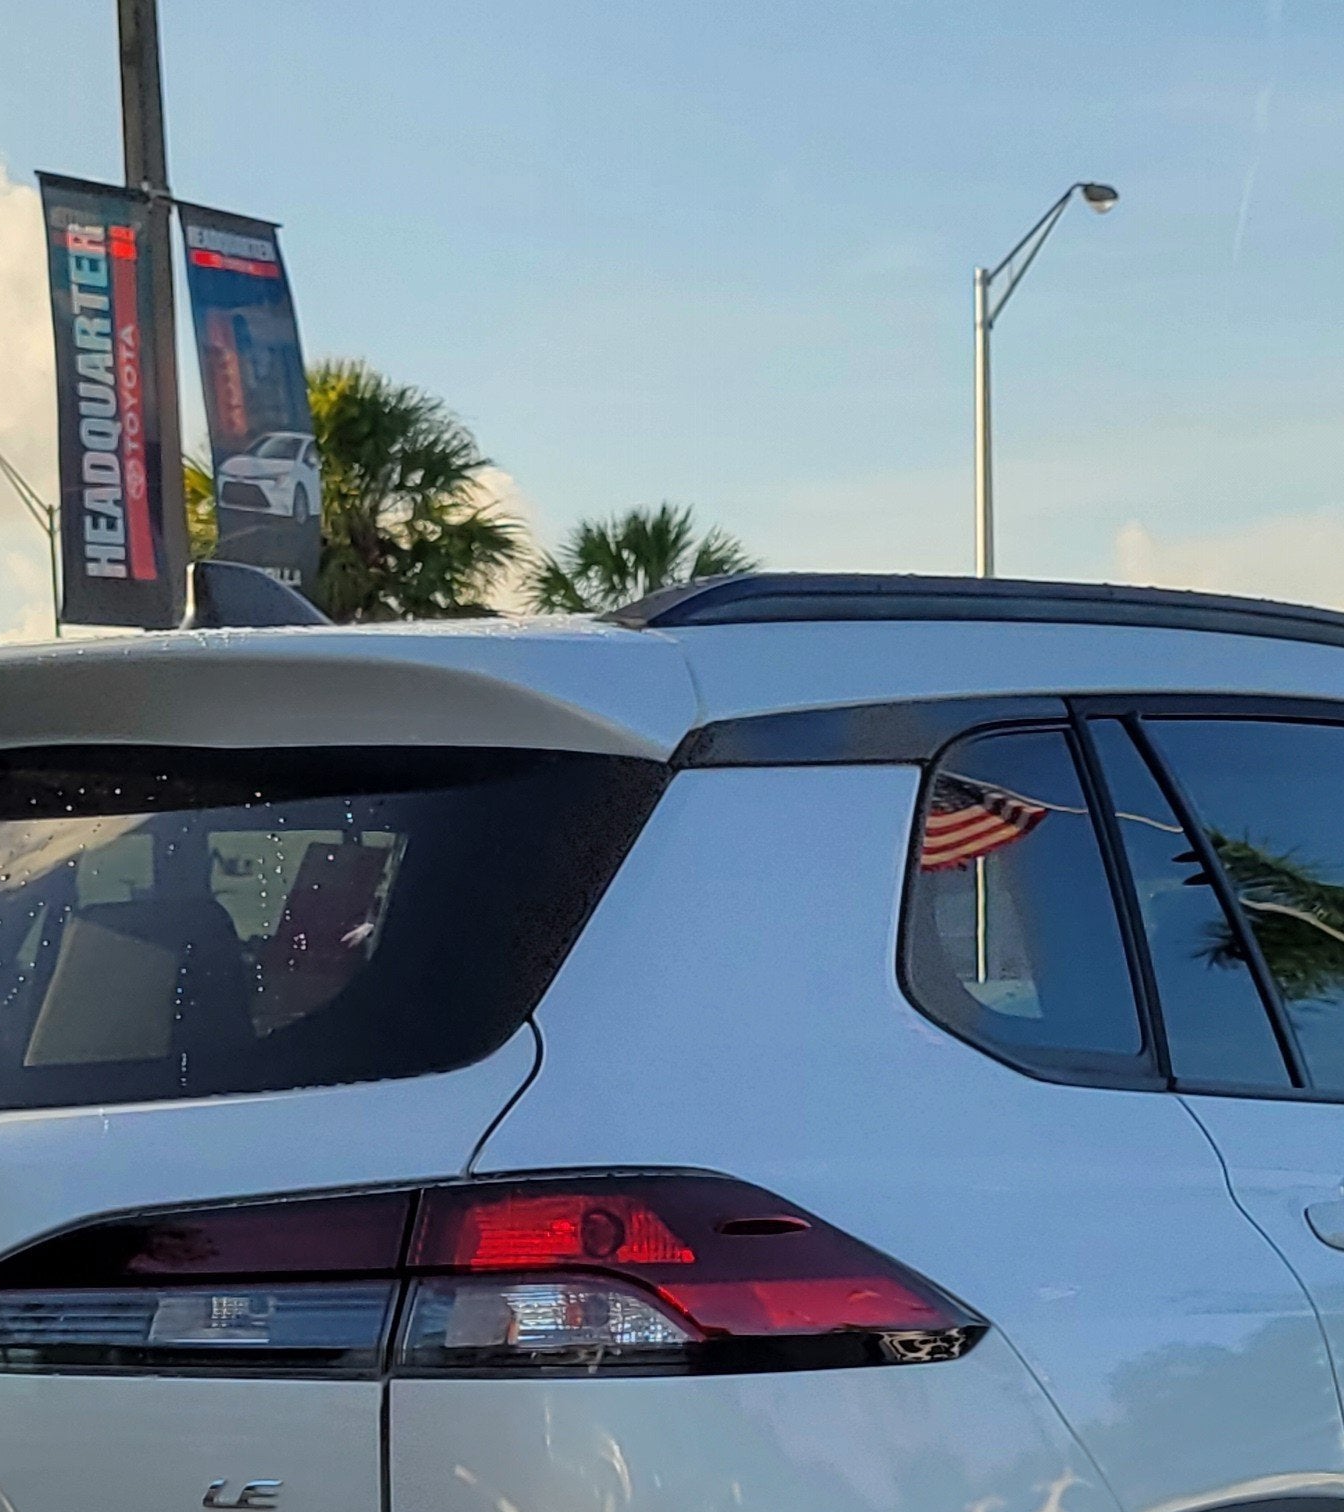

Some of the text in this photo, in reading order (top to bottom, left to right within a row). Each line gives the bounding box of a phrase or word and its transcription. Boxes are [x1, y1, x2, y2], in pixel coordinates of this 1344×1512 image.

[66, 223, 128, 580] HEADQUARTER
[117, 324, 143, 455] TOYOTA
[202, 1478, 284, 1509] LE
